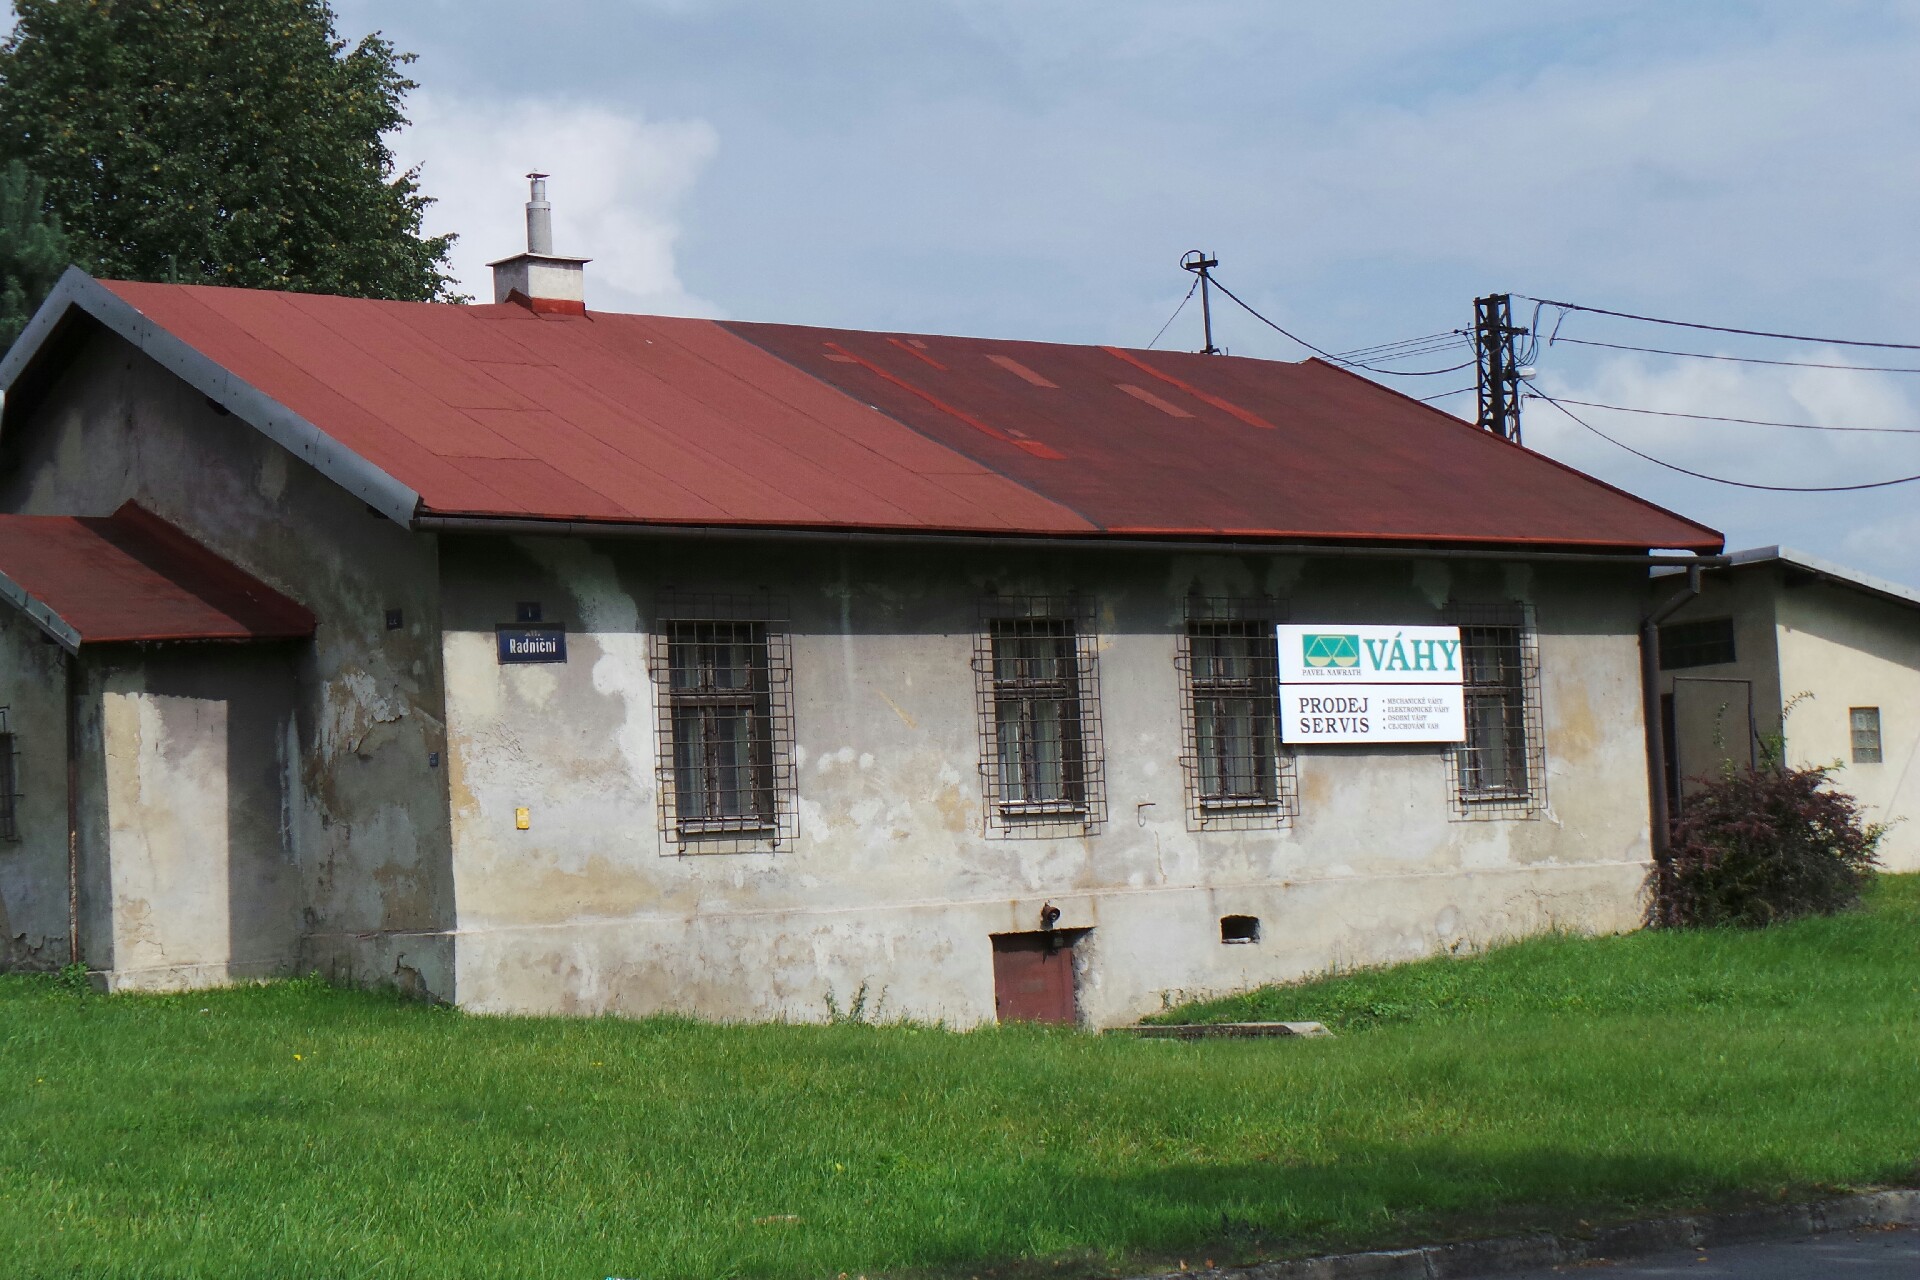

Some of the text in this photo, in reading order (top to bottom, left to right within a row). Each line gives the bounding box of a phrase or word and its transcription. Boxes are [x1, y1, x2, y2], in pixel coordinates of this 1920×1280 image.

[509, 637, 556, 654] Radniční
[1363, 632, 1461, 672] VÁHY
[1302, 669, 1362, 677] PAVEL NAWRATH
[1299, 697, 1369, 714] PRODEJ
[1387, 705, 1450, 713] ELEKTRONICKÉ VÁHY
[1300, 717, 1370, 734] SERVIS
